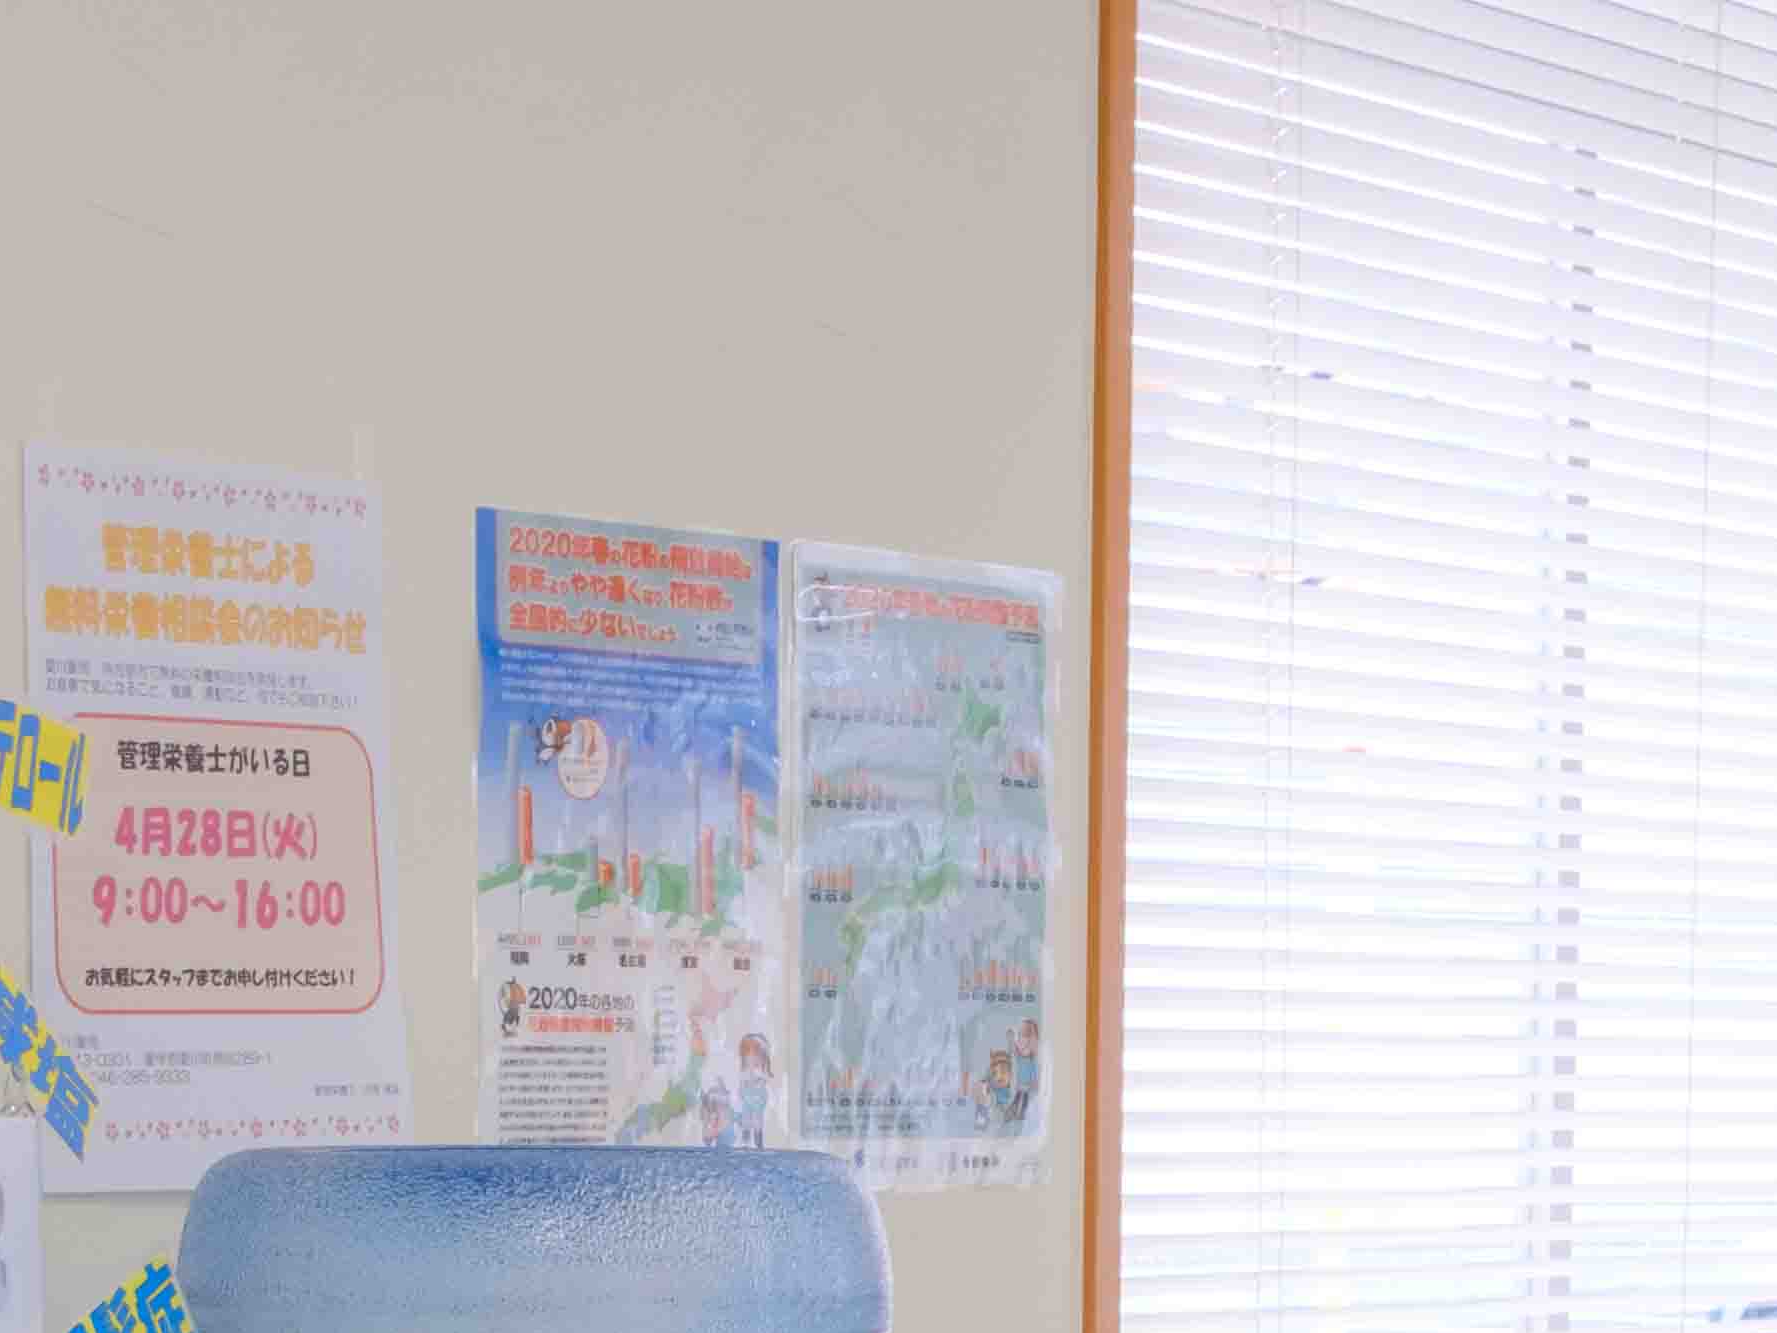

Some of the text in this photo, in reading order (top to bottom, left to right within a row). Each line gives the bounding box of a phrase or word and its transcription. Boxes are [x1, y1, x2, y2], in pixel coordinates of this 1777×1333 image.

[118, 740, 310, 776] 管理栄養士がいる日
